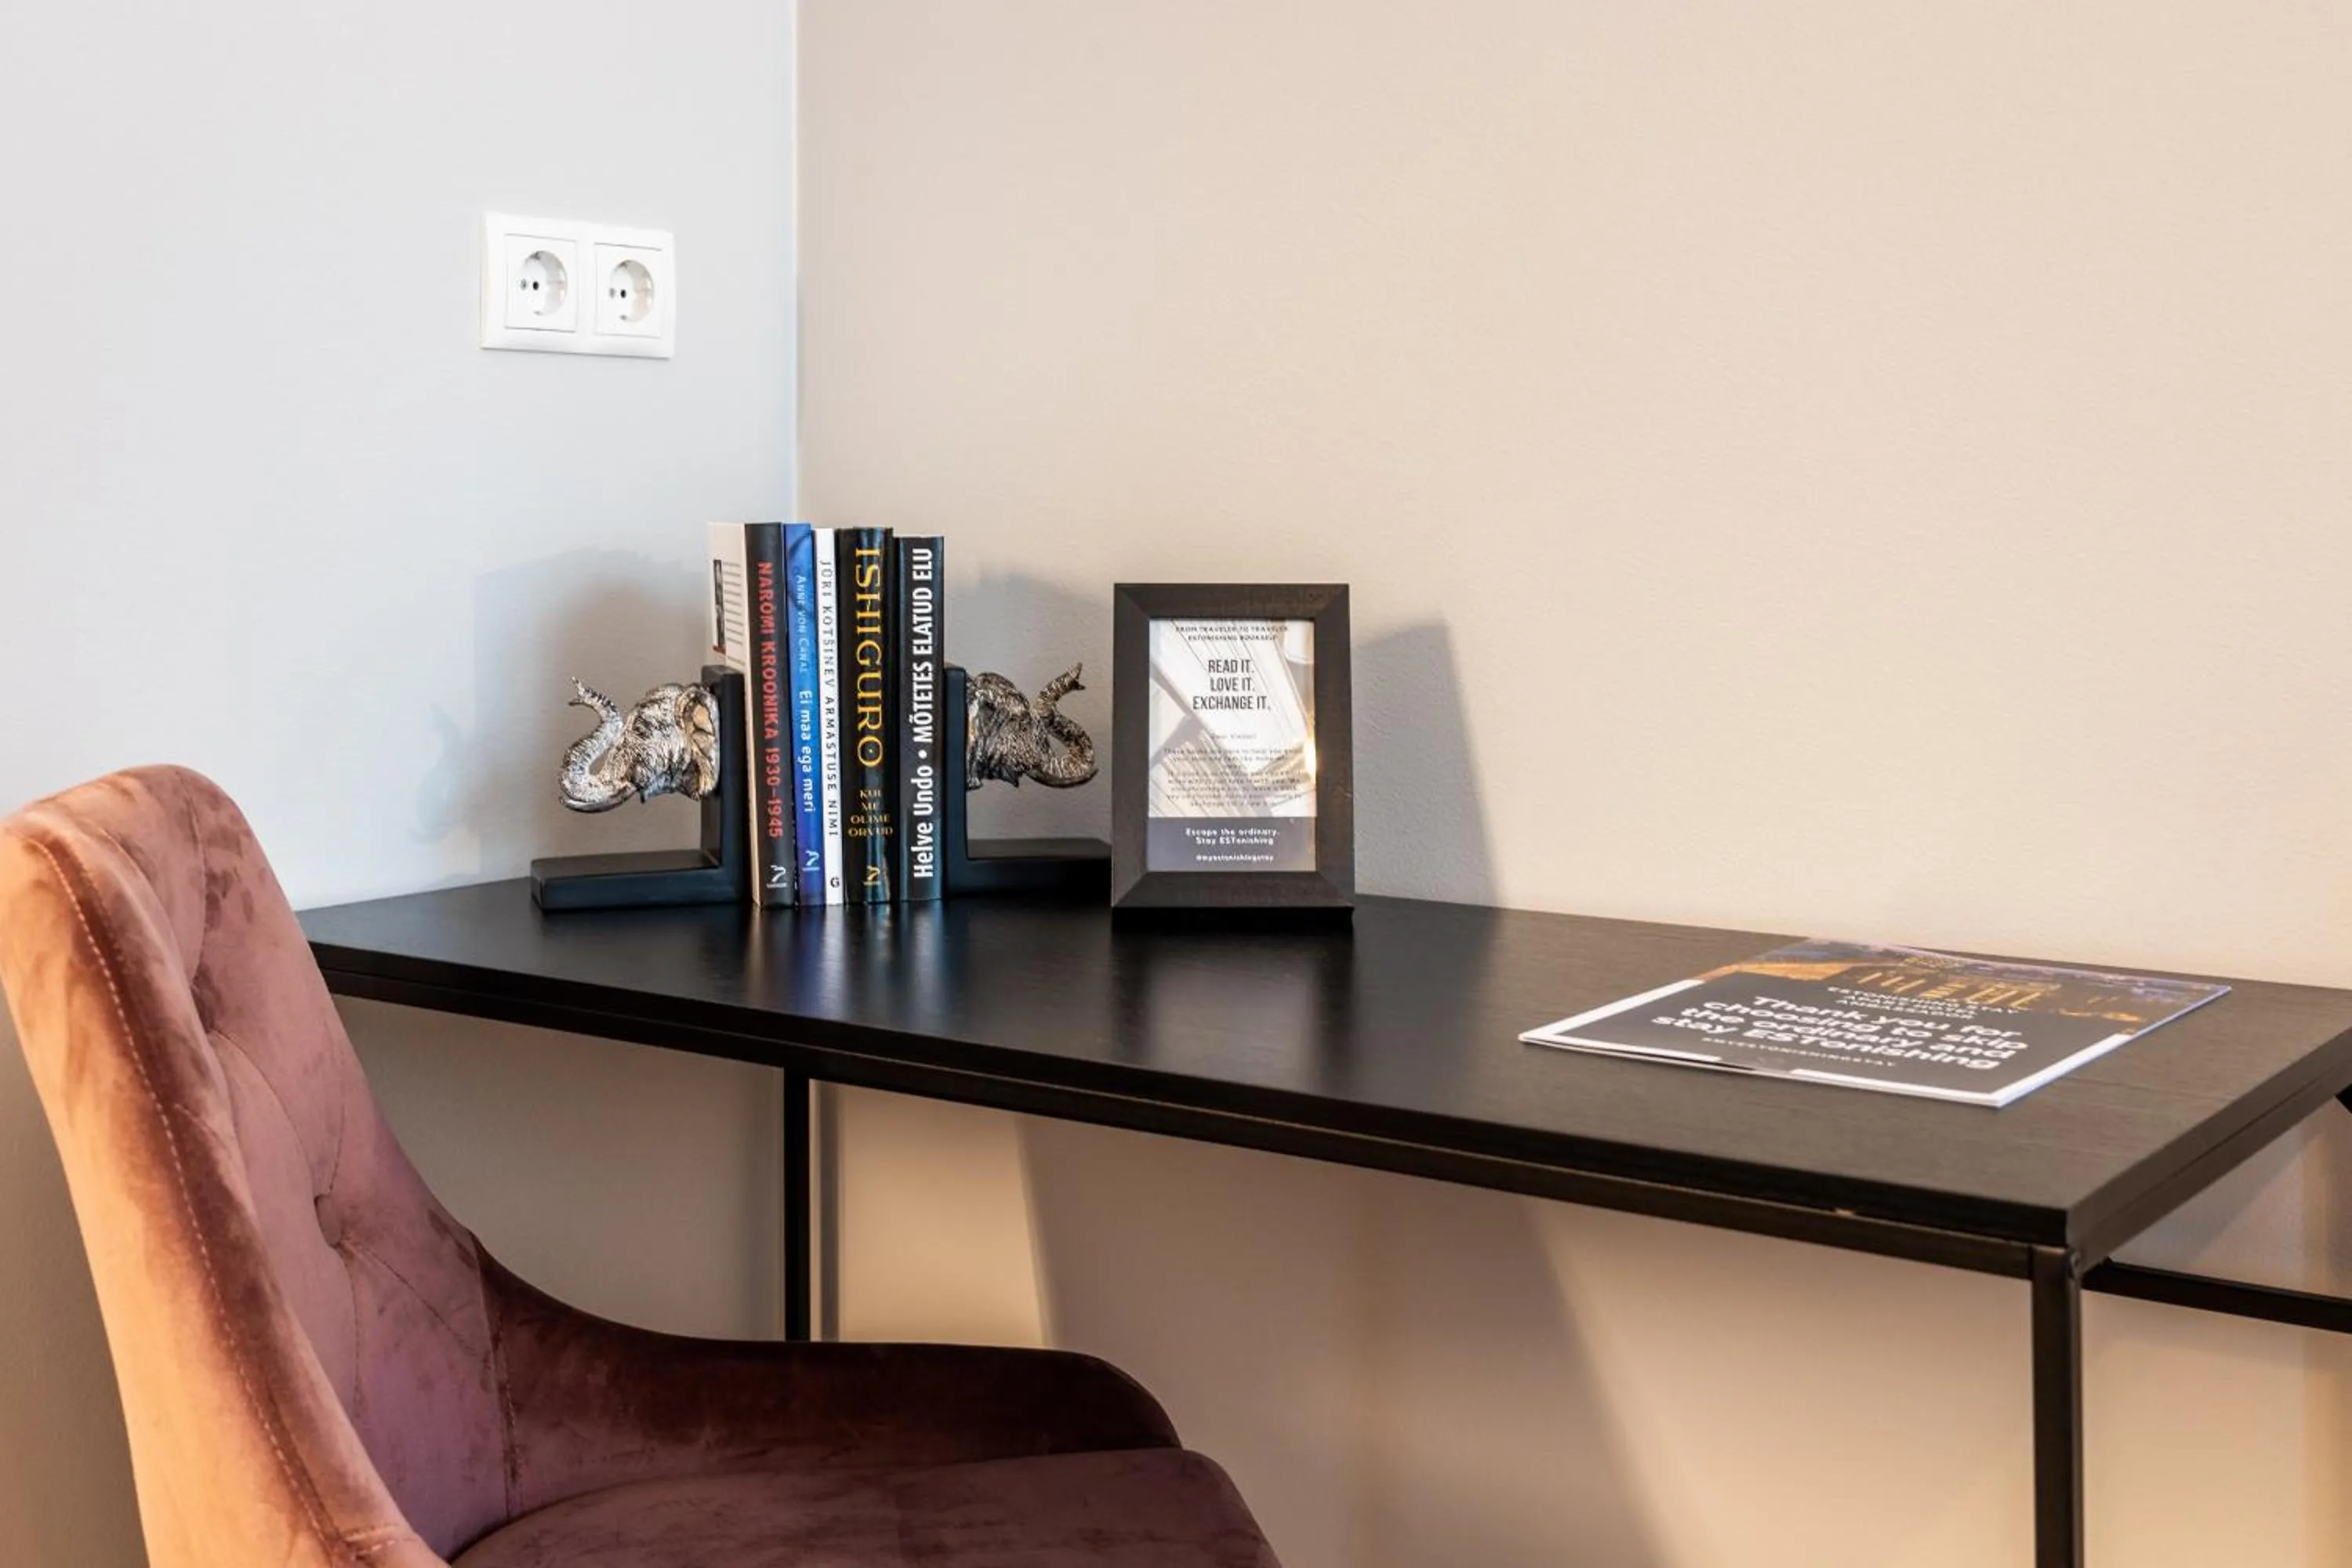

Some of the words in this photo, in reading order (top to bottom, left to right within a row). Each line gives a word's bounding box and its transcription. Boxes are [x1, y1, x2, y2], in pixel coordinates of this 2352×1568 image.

[913, 548, 933, 581] ELU
[913, 587, 933, 655] ELATUD
[855, 548, 884, 768] ISHIGURO
[1208, 659, 1238, 673] READ
[1241, 659, 1254, 673] IT.
[761, 641, 779, 739] KROONIKA
[799, 690, 812, 704] Ei
[909, 661, 934, 743] MÕTETES
[1192, 695, 1253, 710] EXCHANGE
[1257, 695, 1271, 711] IT.
[1210, 677, 1238, 691] LOVE
[1242, 677, 1254, 691] IT.
[800, 710, 811, 740] maa
[825, 696, 837, 791] ARMASTUSE
[798, 746, 813, 772] ega
[803, 779, 815, 812] meri
[910, 765, 934, 816] Undo
[828, 800, 838, 837] NIMI
[910, 822, 934, 877] Helve
[1196, 837, 1216, 845] Stay
[830, 877, 840, 887] G
[1680, 1007, 1745, 1024] the
[1751, 1020, 1924, 1050] ordinary
[1929, 1041, 2017, 1060] and
[1703, 1000, 1882, 1034] choosing
[1890, 1026, 1933, 1039] to
[1940, 1033, 2029, 1051] skip
[1751, 996, 1870, 1021] Thank
[1870, 1014, 1951, 1031] you
[1960, 1024, 2024, 1038] for
[1651, 1016, 1740, 1034] stay
[1742, 1028, 2004, 1070] ESTonishing
